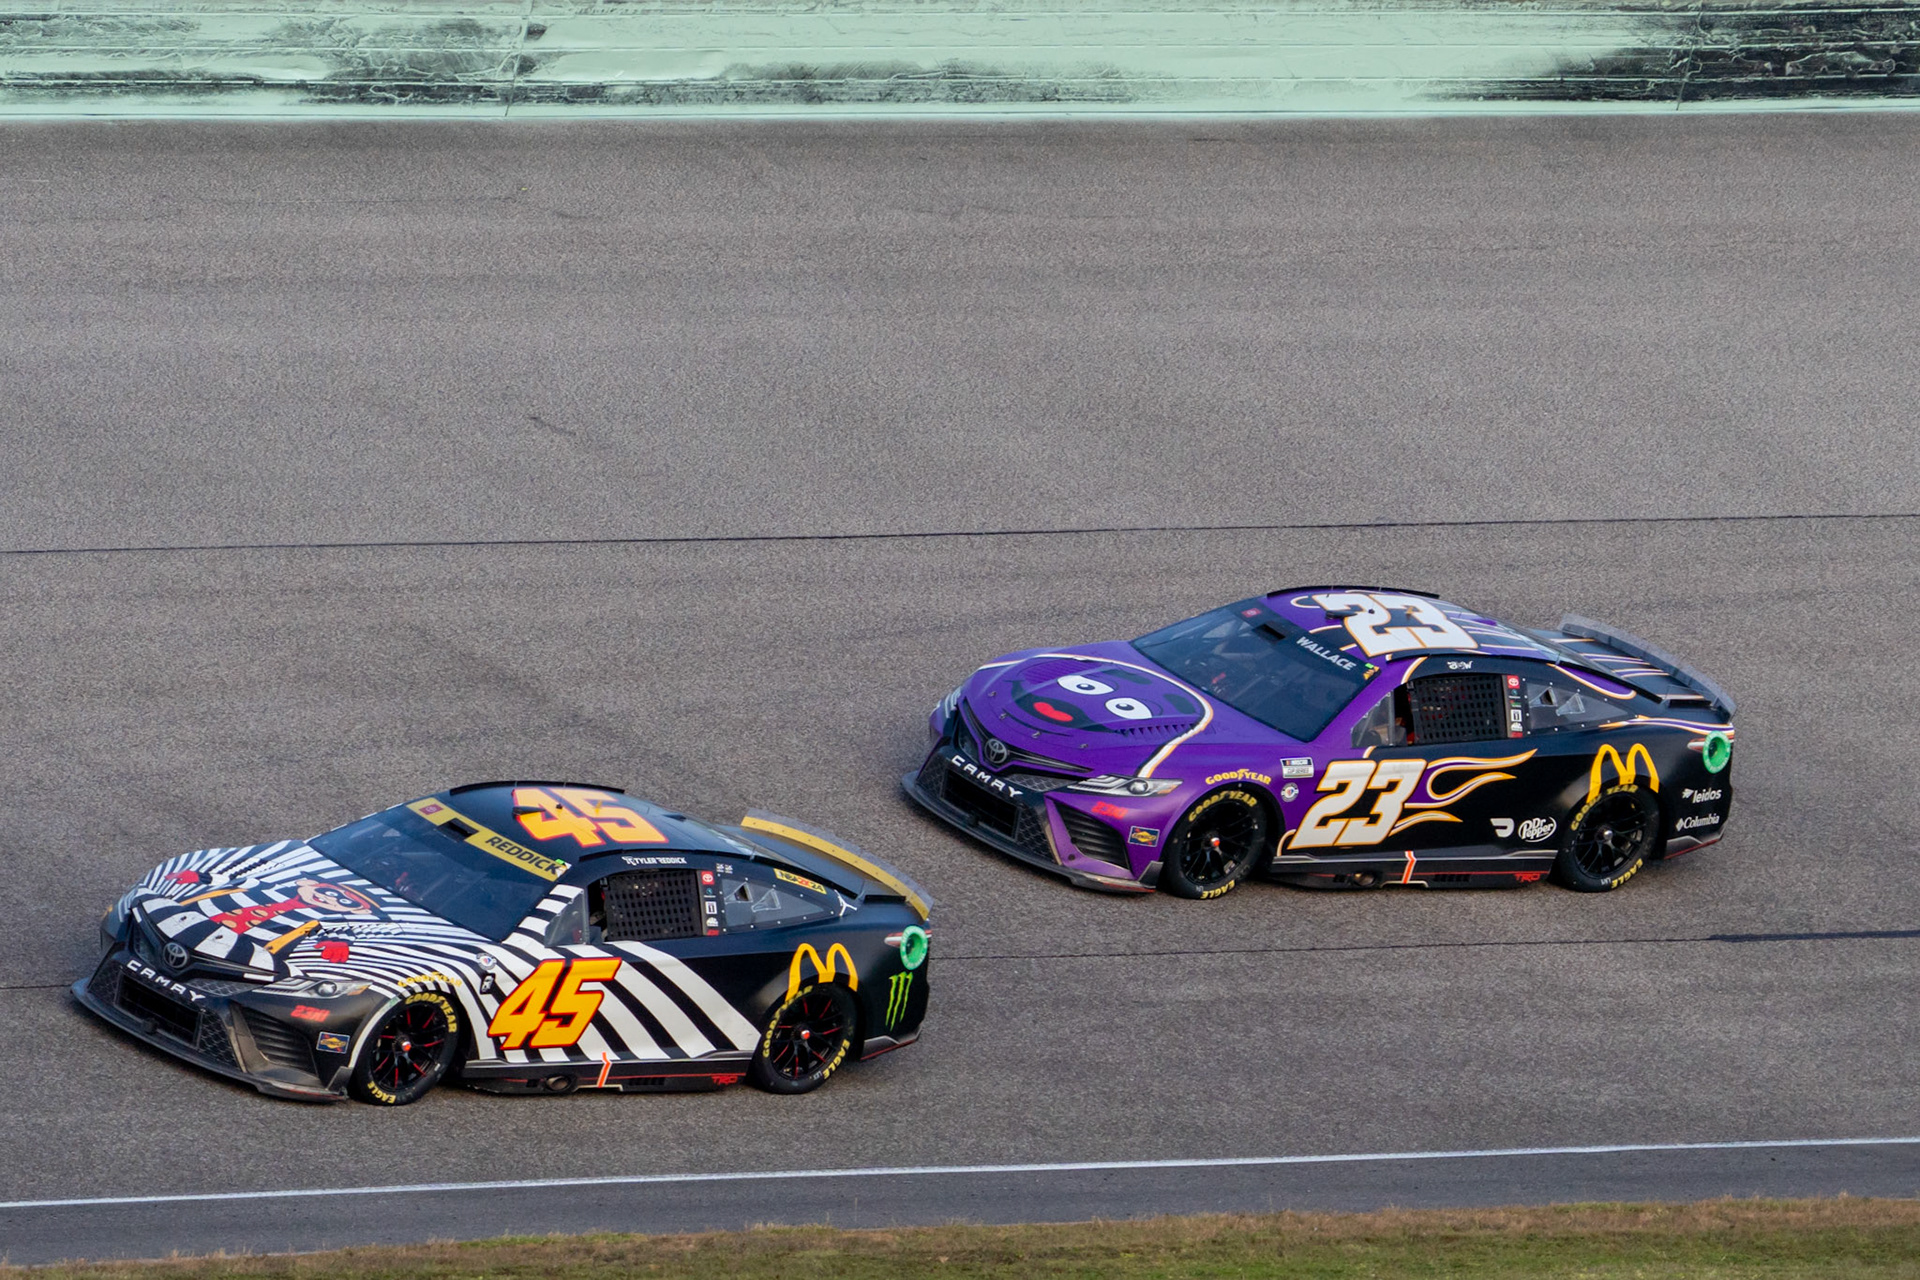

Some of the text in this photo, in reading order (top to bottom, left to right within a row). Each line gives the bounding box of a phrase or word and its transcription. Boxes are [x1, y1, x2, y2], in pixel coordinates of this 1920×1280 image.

[1311, 593, 1478, 657] 23
[1296, 635, 1357, 671] WALLACE
[951, 754, 1023, 798] CAMRY
[1205, 768, 1272, 785] GOODYEAR
[1188, 790, 1258, 822] GOODYEAR
[1287, 758, 1428, 850] 23
[1692, 787, 1722, 804] leidos
[511, 787, 669, 848] 45
[1520, 820, 1554, 840] Pepper
[1532, 817, 1547, 829] Dr
[1683, 813, 1720, 830] Columbia
[485, 835, 559, 876] REDDICK
[634, 857, 657, 865] TYLER
[1200, 879, 1236, 899] EAGLE
[1610, 858, 1643, 889] EAGLE
[126, 959, 206, 1002] CAMRY
[397, 971, 462, 994] GOODYEAR
[405, 992, 458, 1033] GOODYEAR
[487, 957, 622, 1050] 45
[822, 1039, 851, 1079] EAGLE
[367, 1080, 396, 1104] EAGLE
